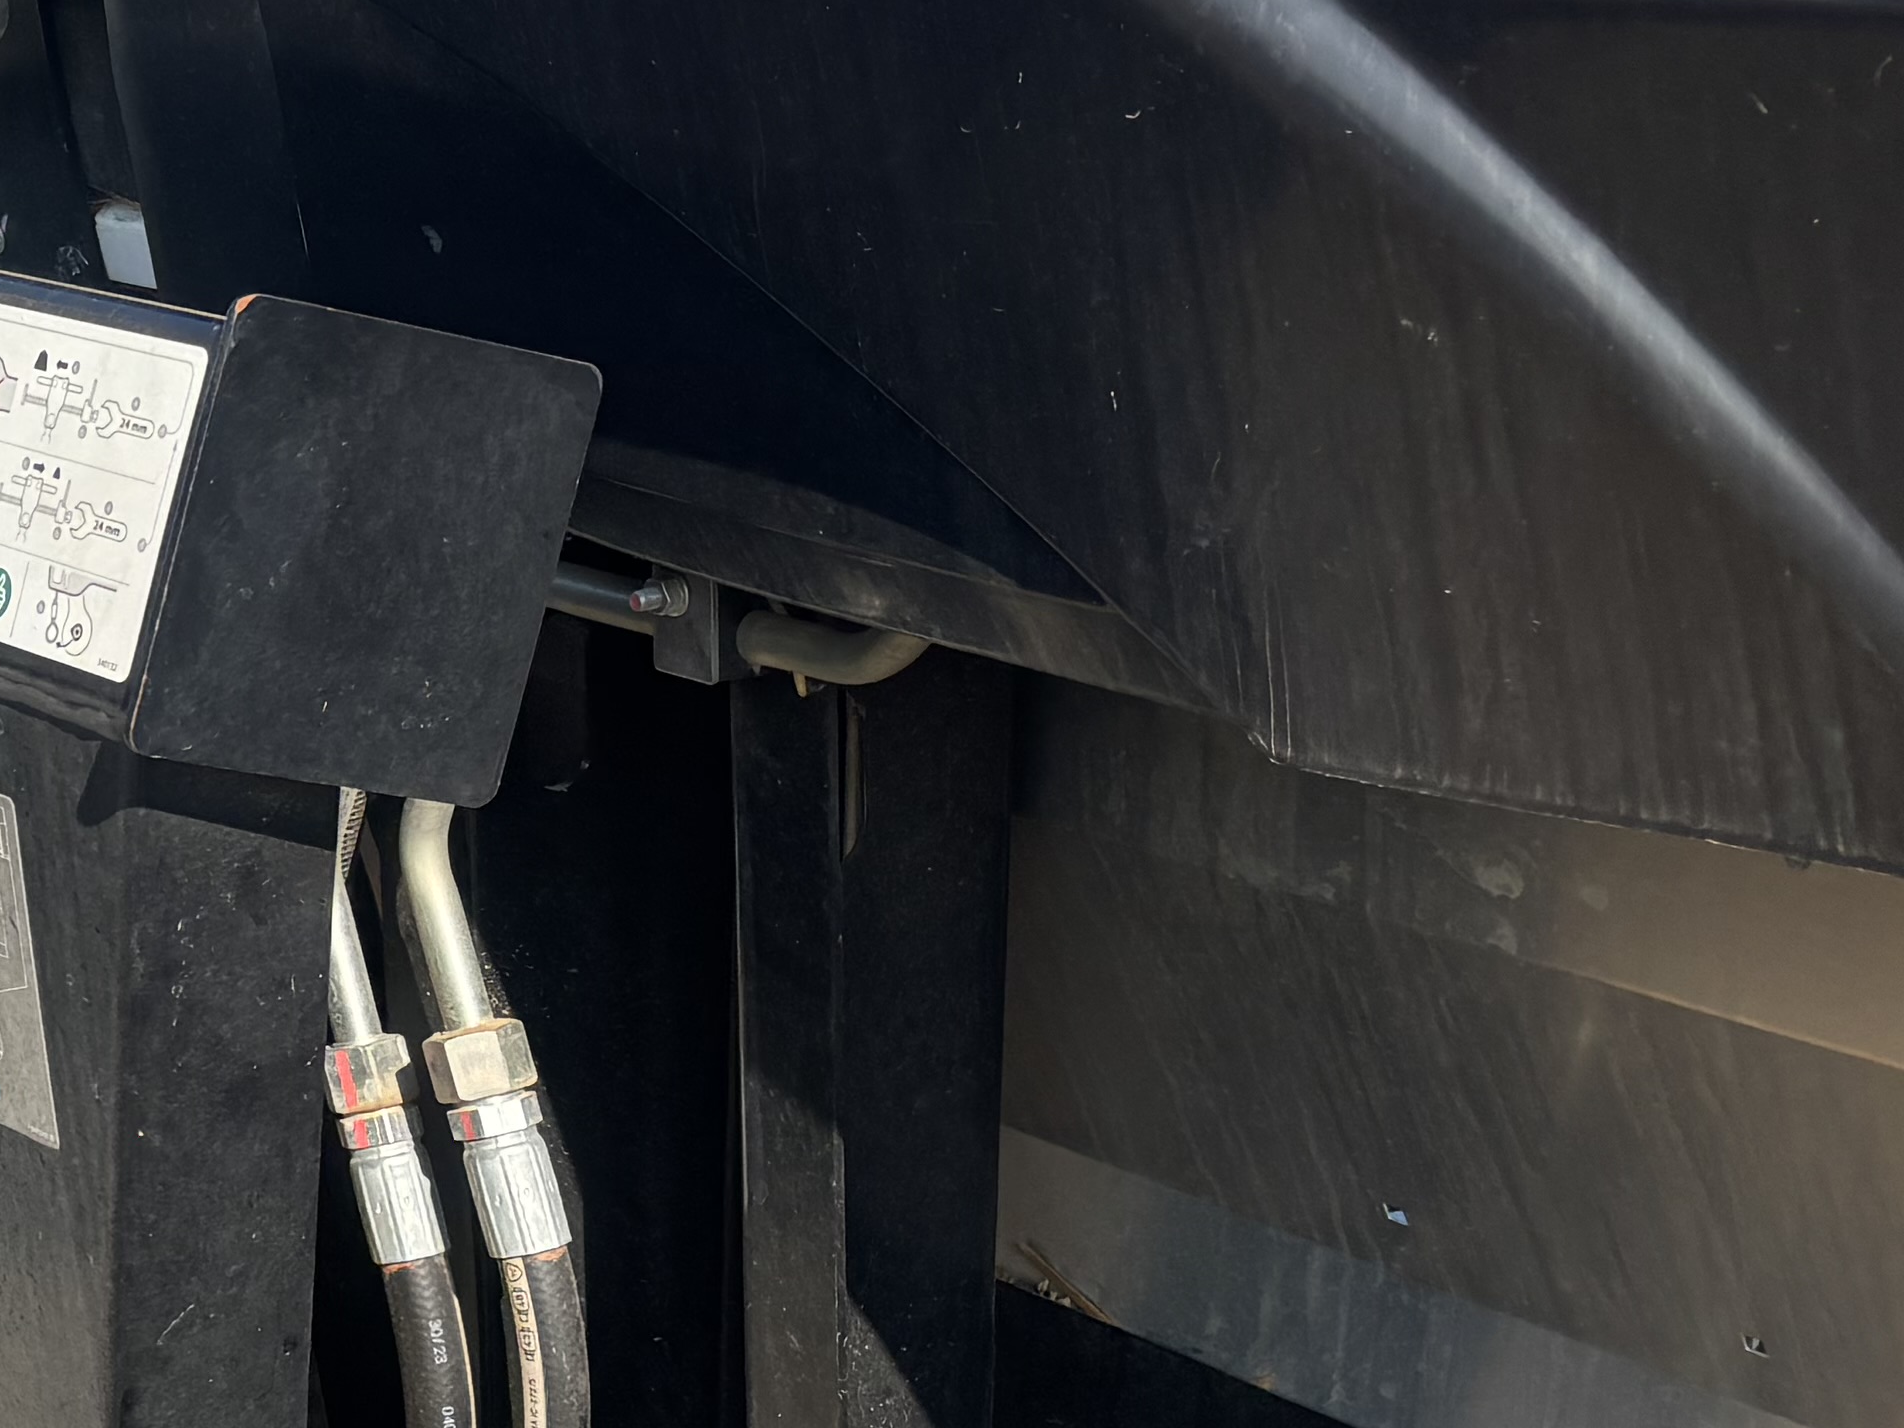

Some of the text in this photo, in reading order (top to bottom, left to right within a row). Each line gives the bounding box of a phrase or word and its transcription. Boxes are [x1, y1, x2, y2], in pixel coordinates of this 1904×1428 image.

[118, 415, 148, 436] 24 mm
[92, 519, 121, 537] 24 mm
[428, 1318, 449, 1366] 30/23
